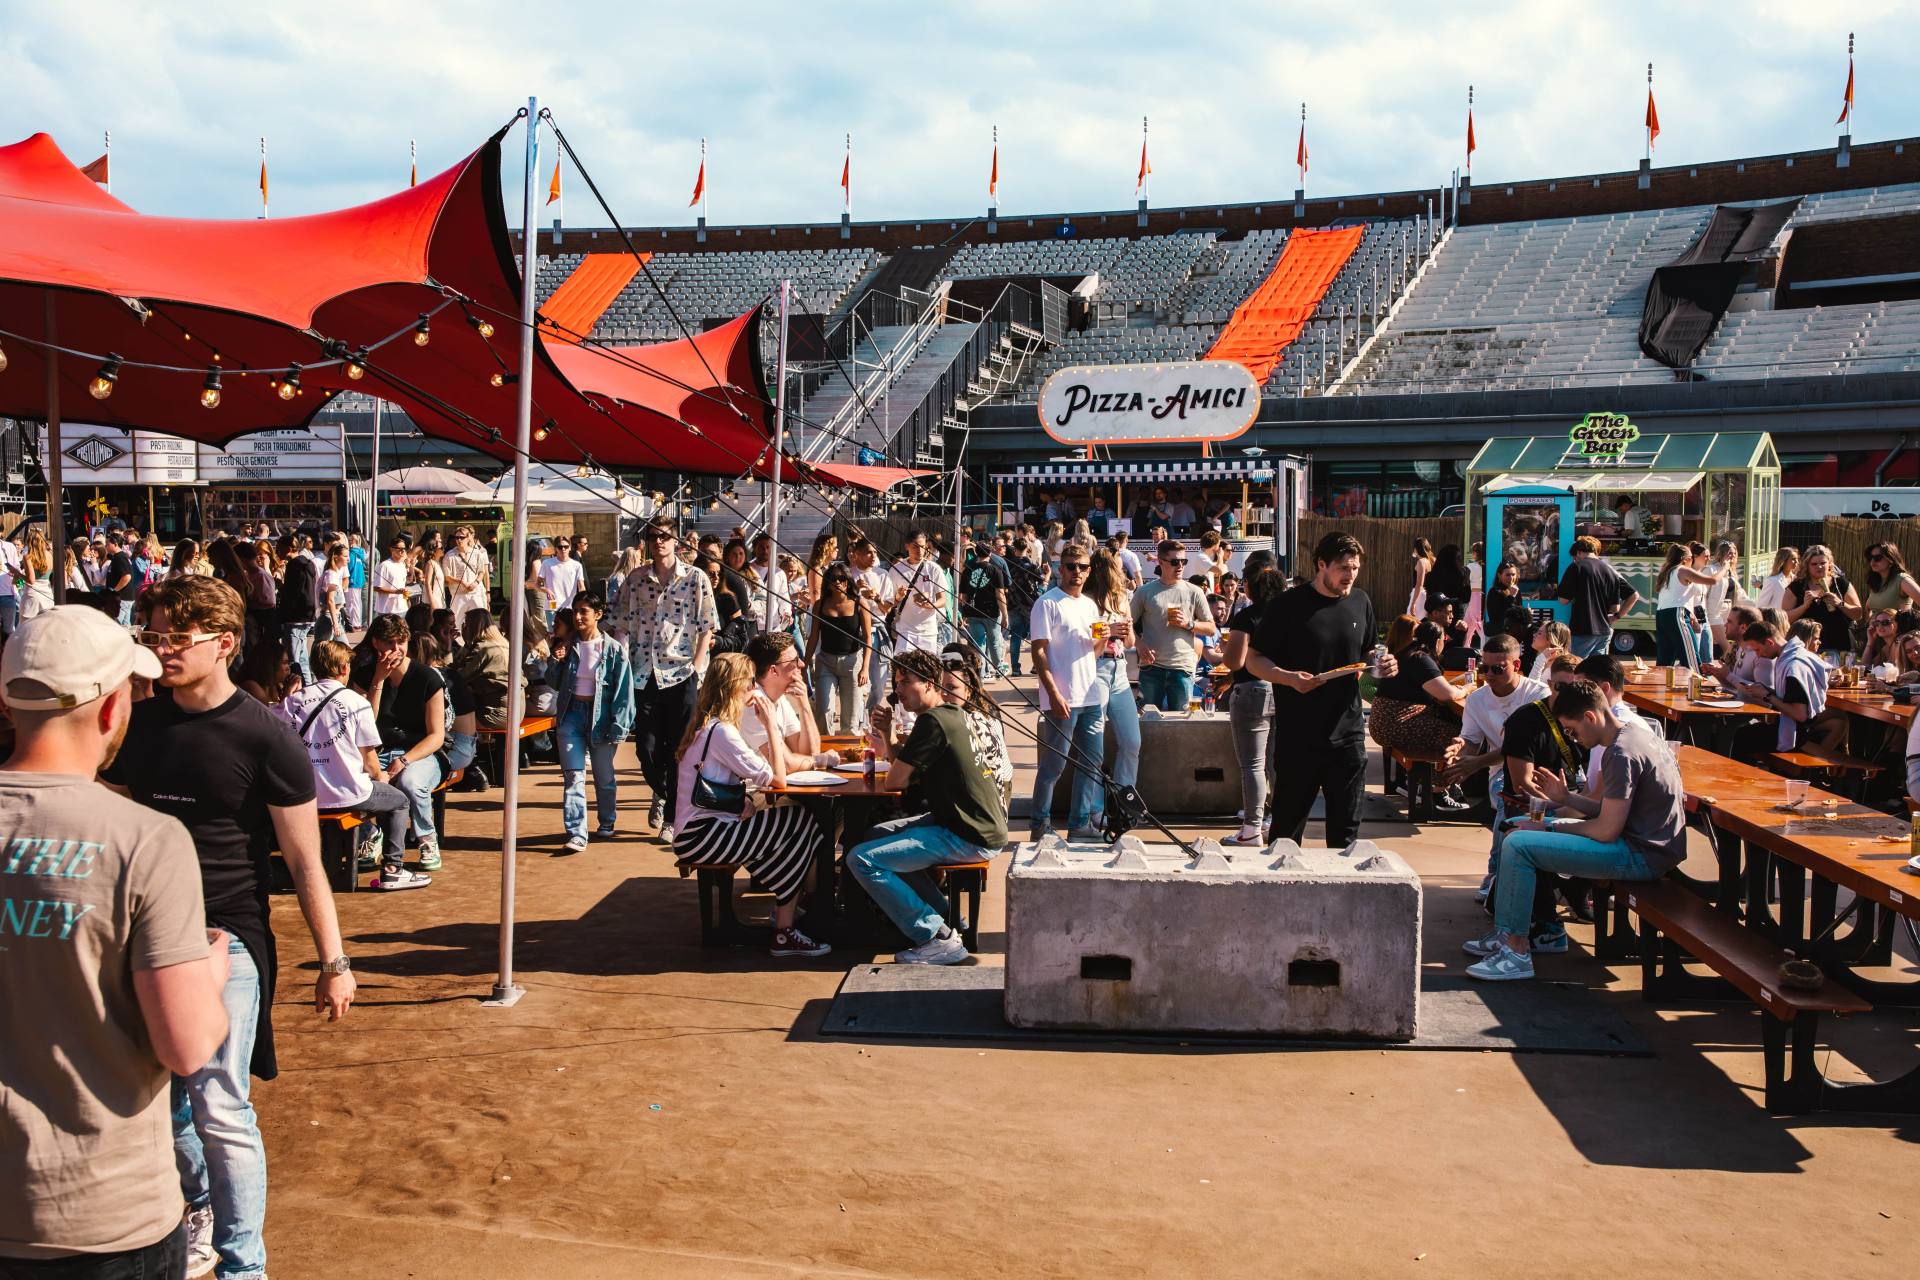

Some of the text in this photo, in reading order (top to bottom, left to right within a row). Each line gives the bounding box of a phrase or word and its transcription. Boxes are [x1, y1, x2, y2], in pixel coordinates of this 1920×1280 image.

[1588, 415, 1624, 427] The
[1573, 427, 1635, 440] Green
[253, 442, 312, 451] PASTA TRADIZIONALE
[1584, 441, 1623, 454] Bar
[76, 441, 113, 465] PASTA AMICI
[216, 456, 278, 466] PESTO ALLA GENOVESE
[1871, 500, 1890, 512] De
[3, 838, 105, 878] THE
